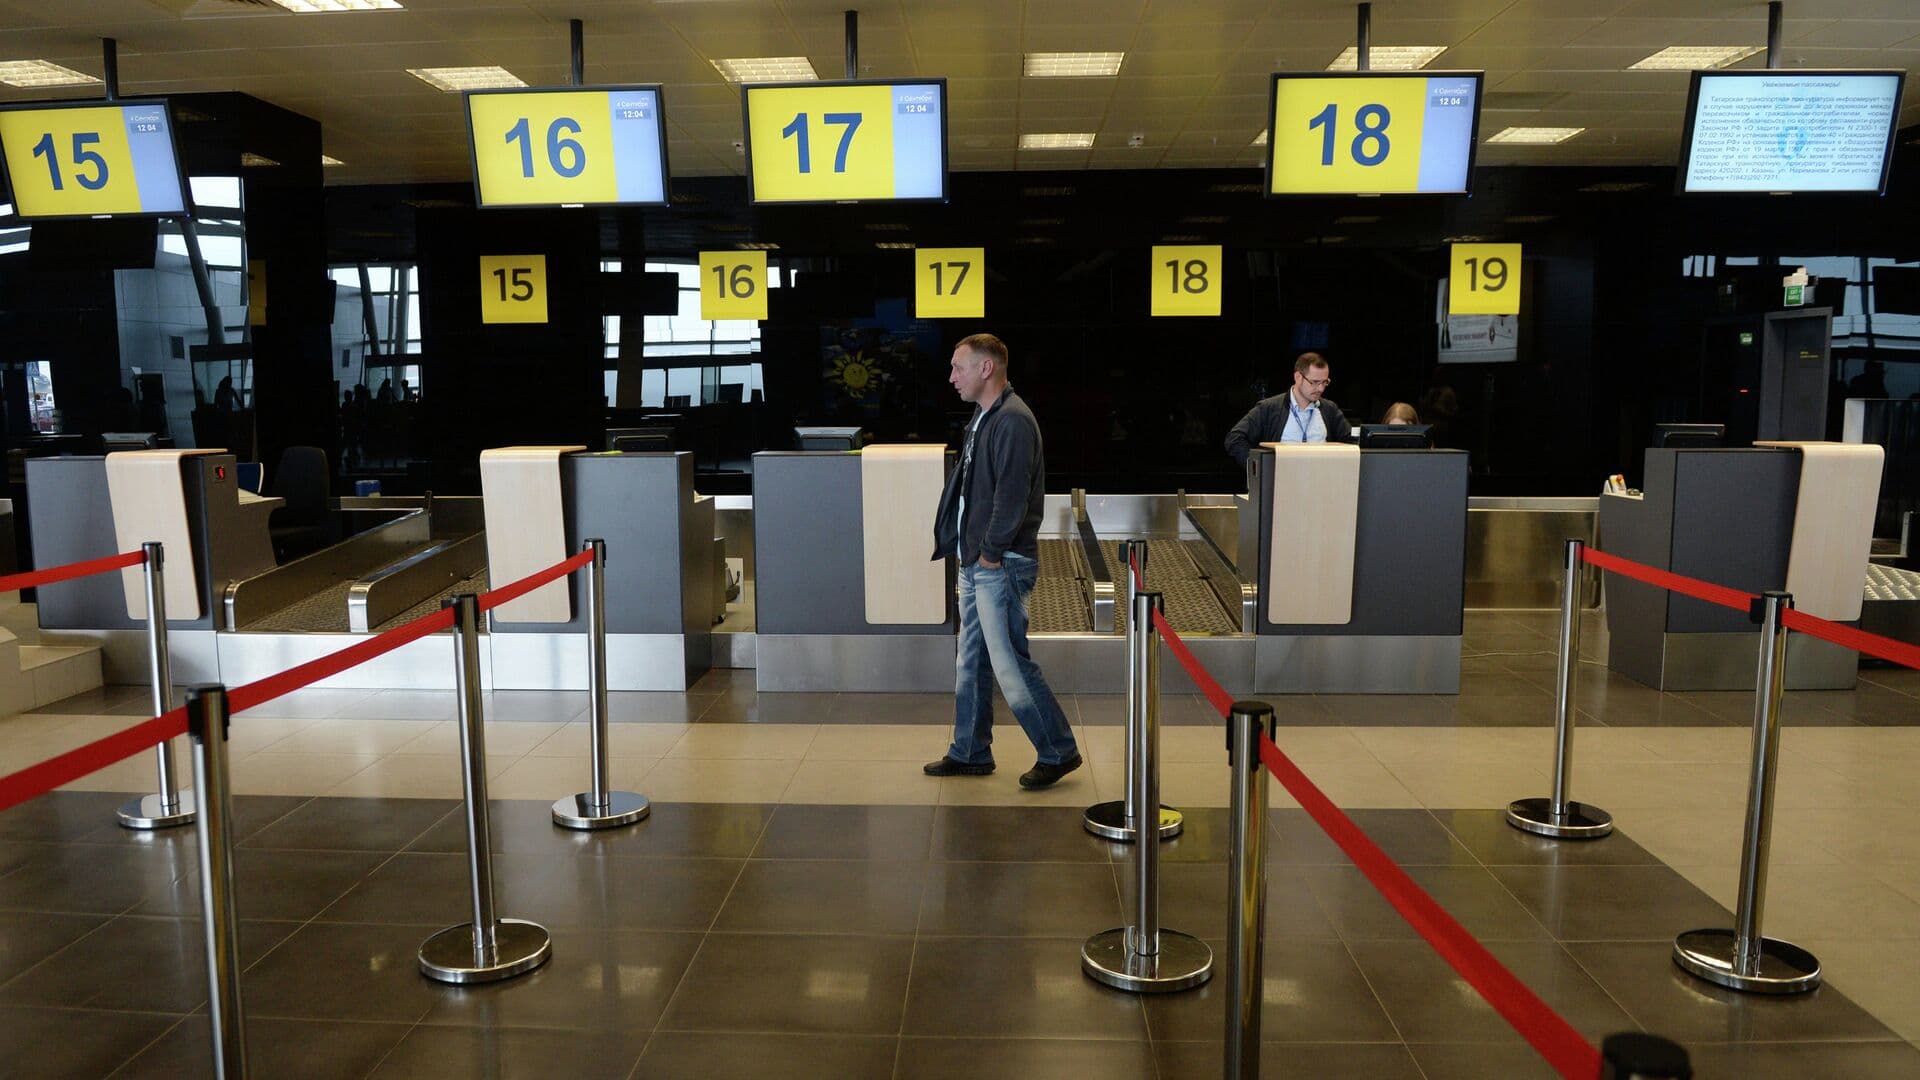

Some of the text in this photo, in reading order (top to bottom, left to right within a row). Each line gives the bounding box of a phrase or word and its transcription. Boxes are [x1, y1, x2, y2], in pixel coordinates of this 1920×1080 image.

[505, 117, 586, 178] 16
[782, 112, 863, 174] 17
[1309, 103, 1391, 167] 18
[32, 132, 109, 191] 15
[492, 267, 534, 302] 15
[712, 264, 755, 299] 16
[928, 261, 971, 296] 17
[1165, 259, 1209, 294] 18
[1464, 257, 1508, 292] 19
